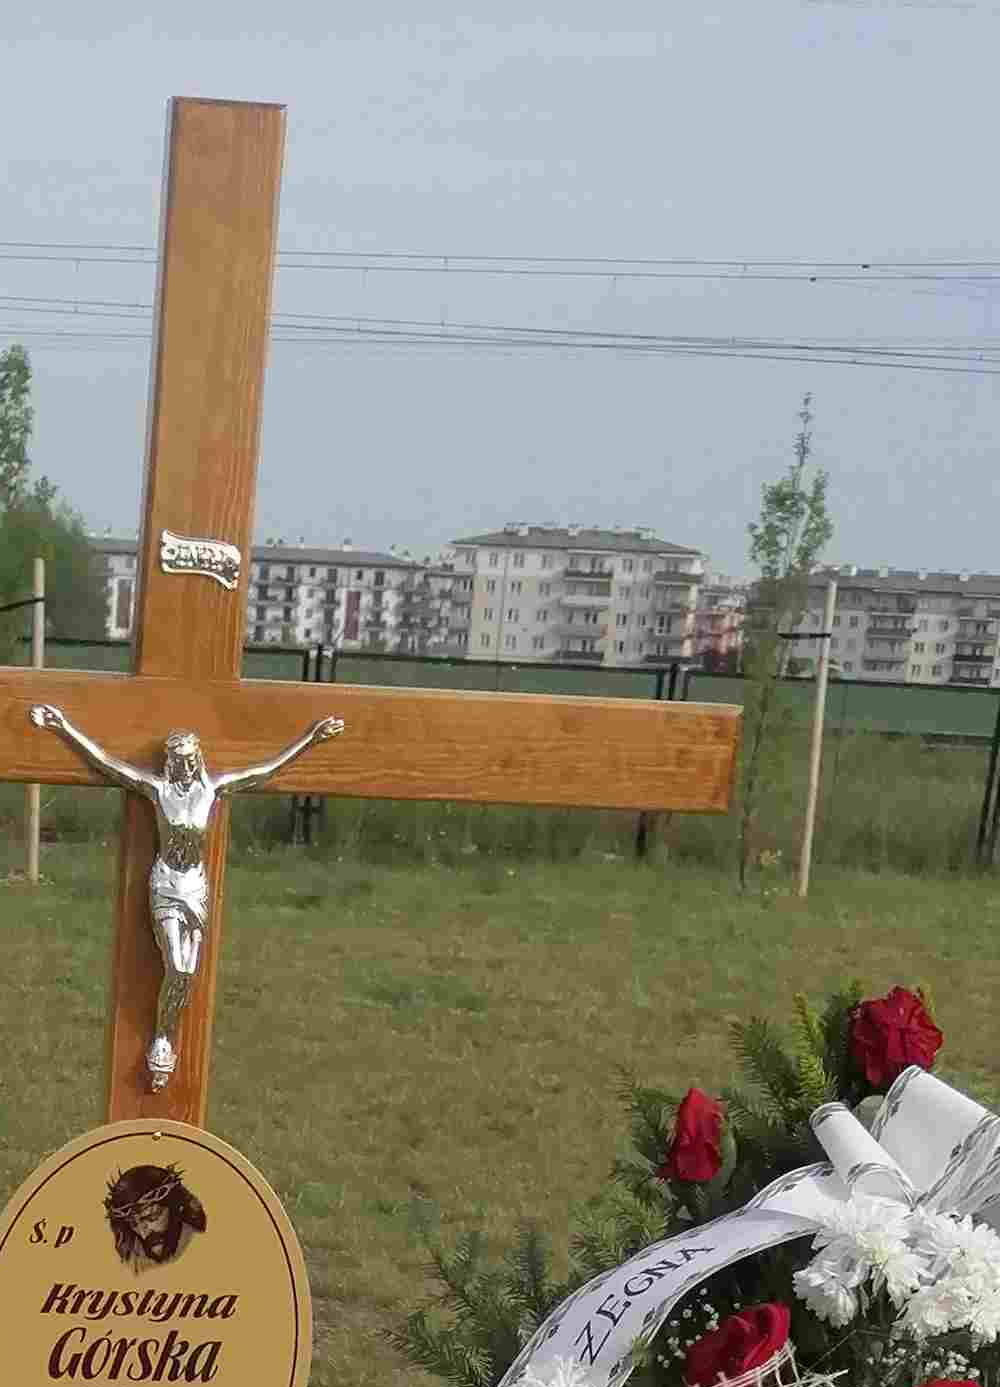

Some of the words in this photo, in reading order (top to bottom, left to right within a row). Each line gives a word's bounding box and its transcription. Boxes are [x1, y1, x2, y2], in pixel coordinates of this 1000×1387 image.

[54, 1225, 75, 1248] p
[39, 1283, 240, 1323] Krystyna
[47, 1327, 224, 1382] Górska
